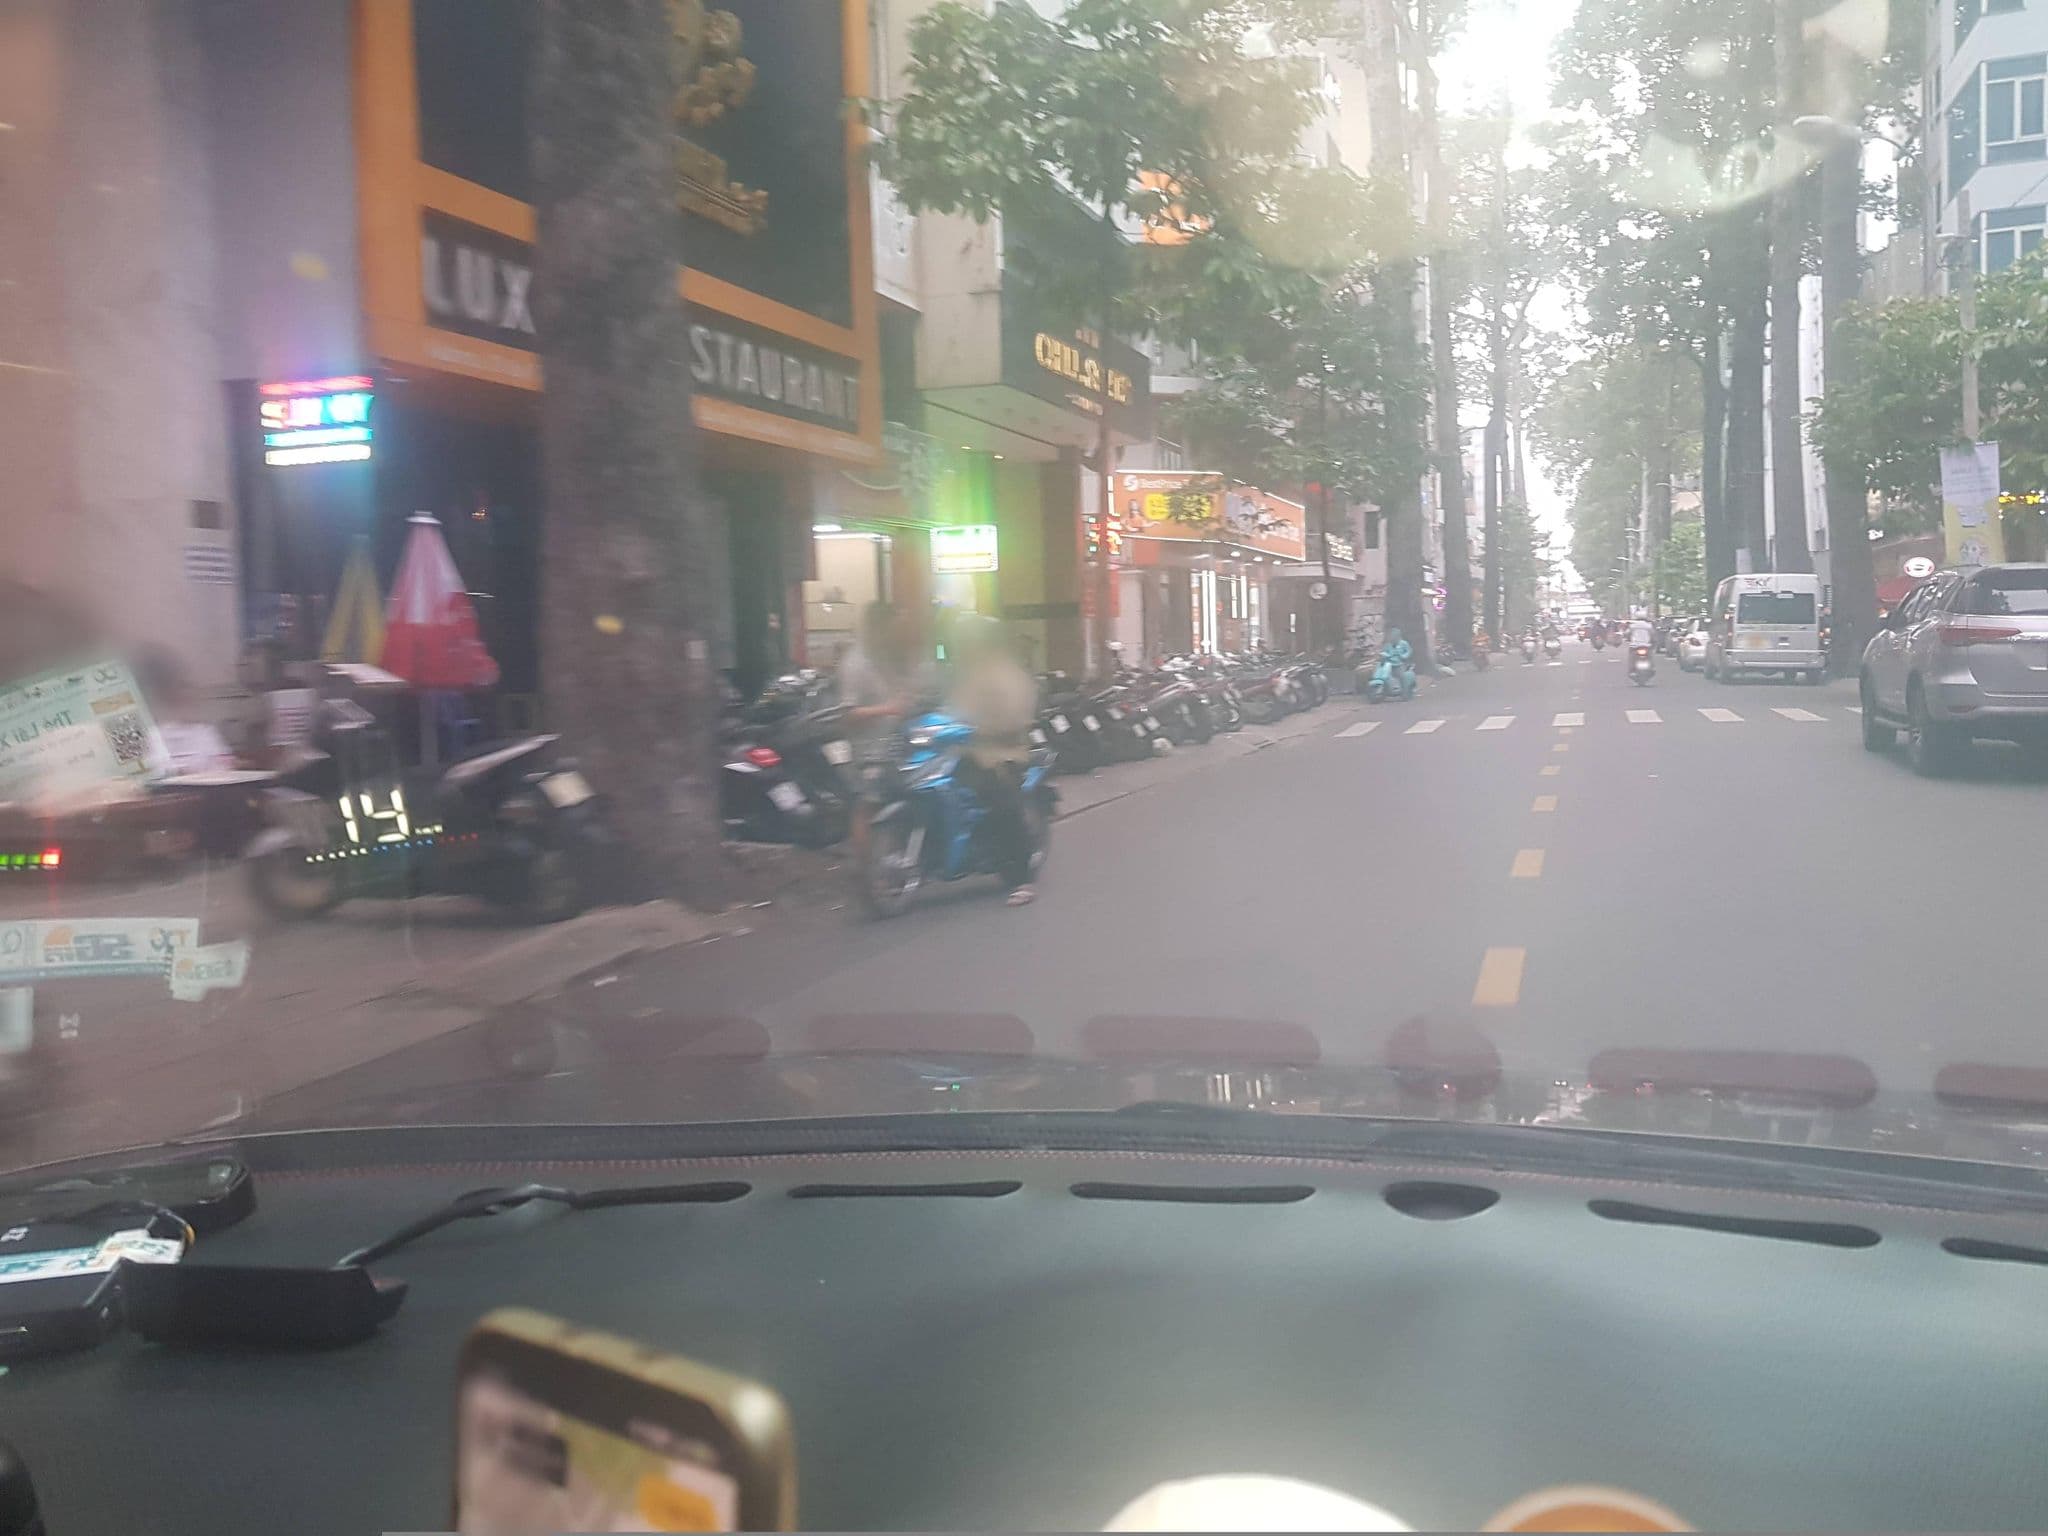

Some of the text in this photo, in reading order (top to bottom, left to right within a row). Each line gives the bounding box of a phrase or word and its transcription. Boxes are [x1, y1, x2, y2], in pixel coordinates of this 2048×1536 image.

[422, 238, 536, 334] LUX
[689, 325, 857, 422] STAURANT
[338, 789, 410, 843] 19
